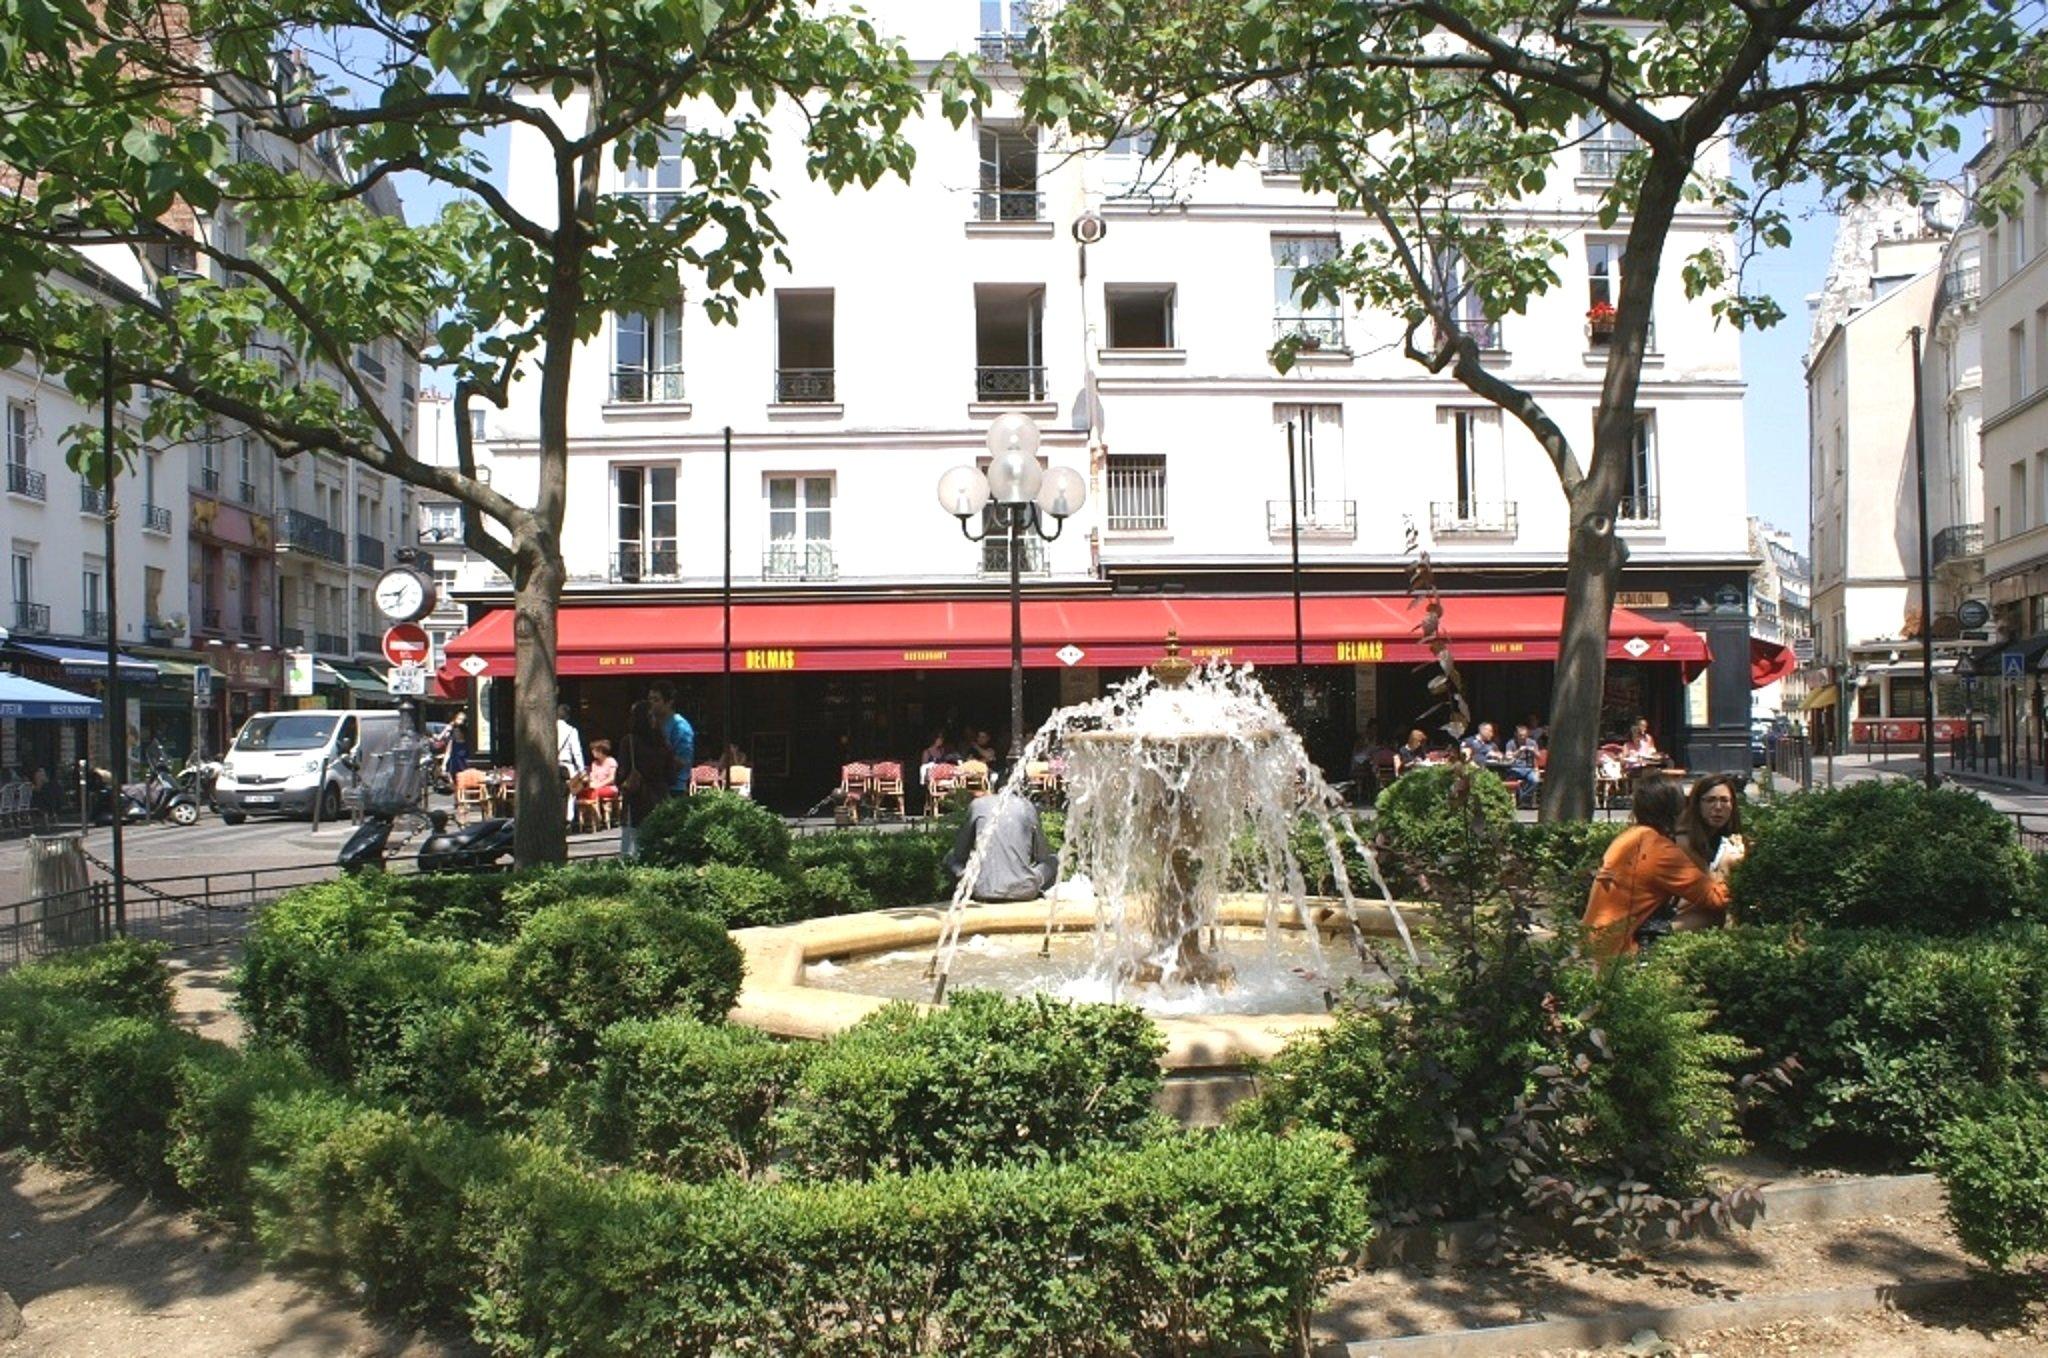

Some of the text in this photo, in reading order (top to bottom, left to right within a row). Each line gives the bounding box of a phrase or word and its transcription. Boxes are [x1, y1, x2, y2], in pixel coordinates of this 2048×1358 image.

[1618, 592, 1653, 605] SALON
[746, 649, 795, 669] DELMAS
[1337, 641, 1383, 661] DELMAS
